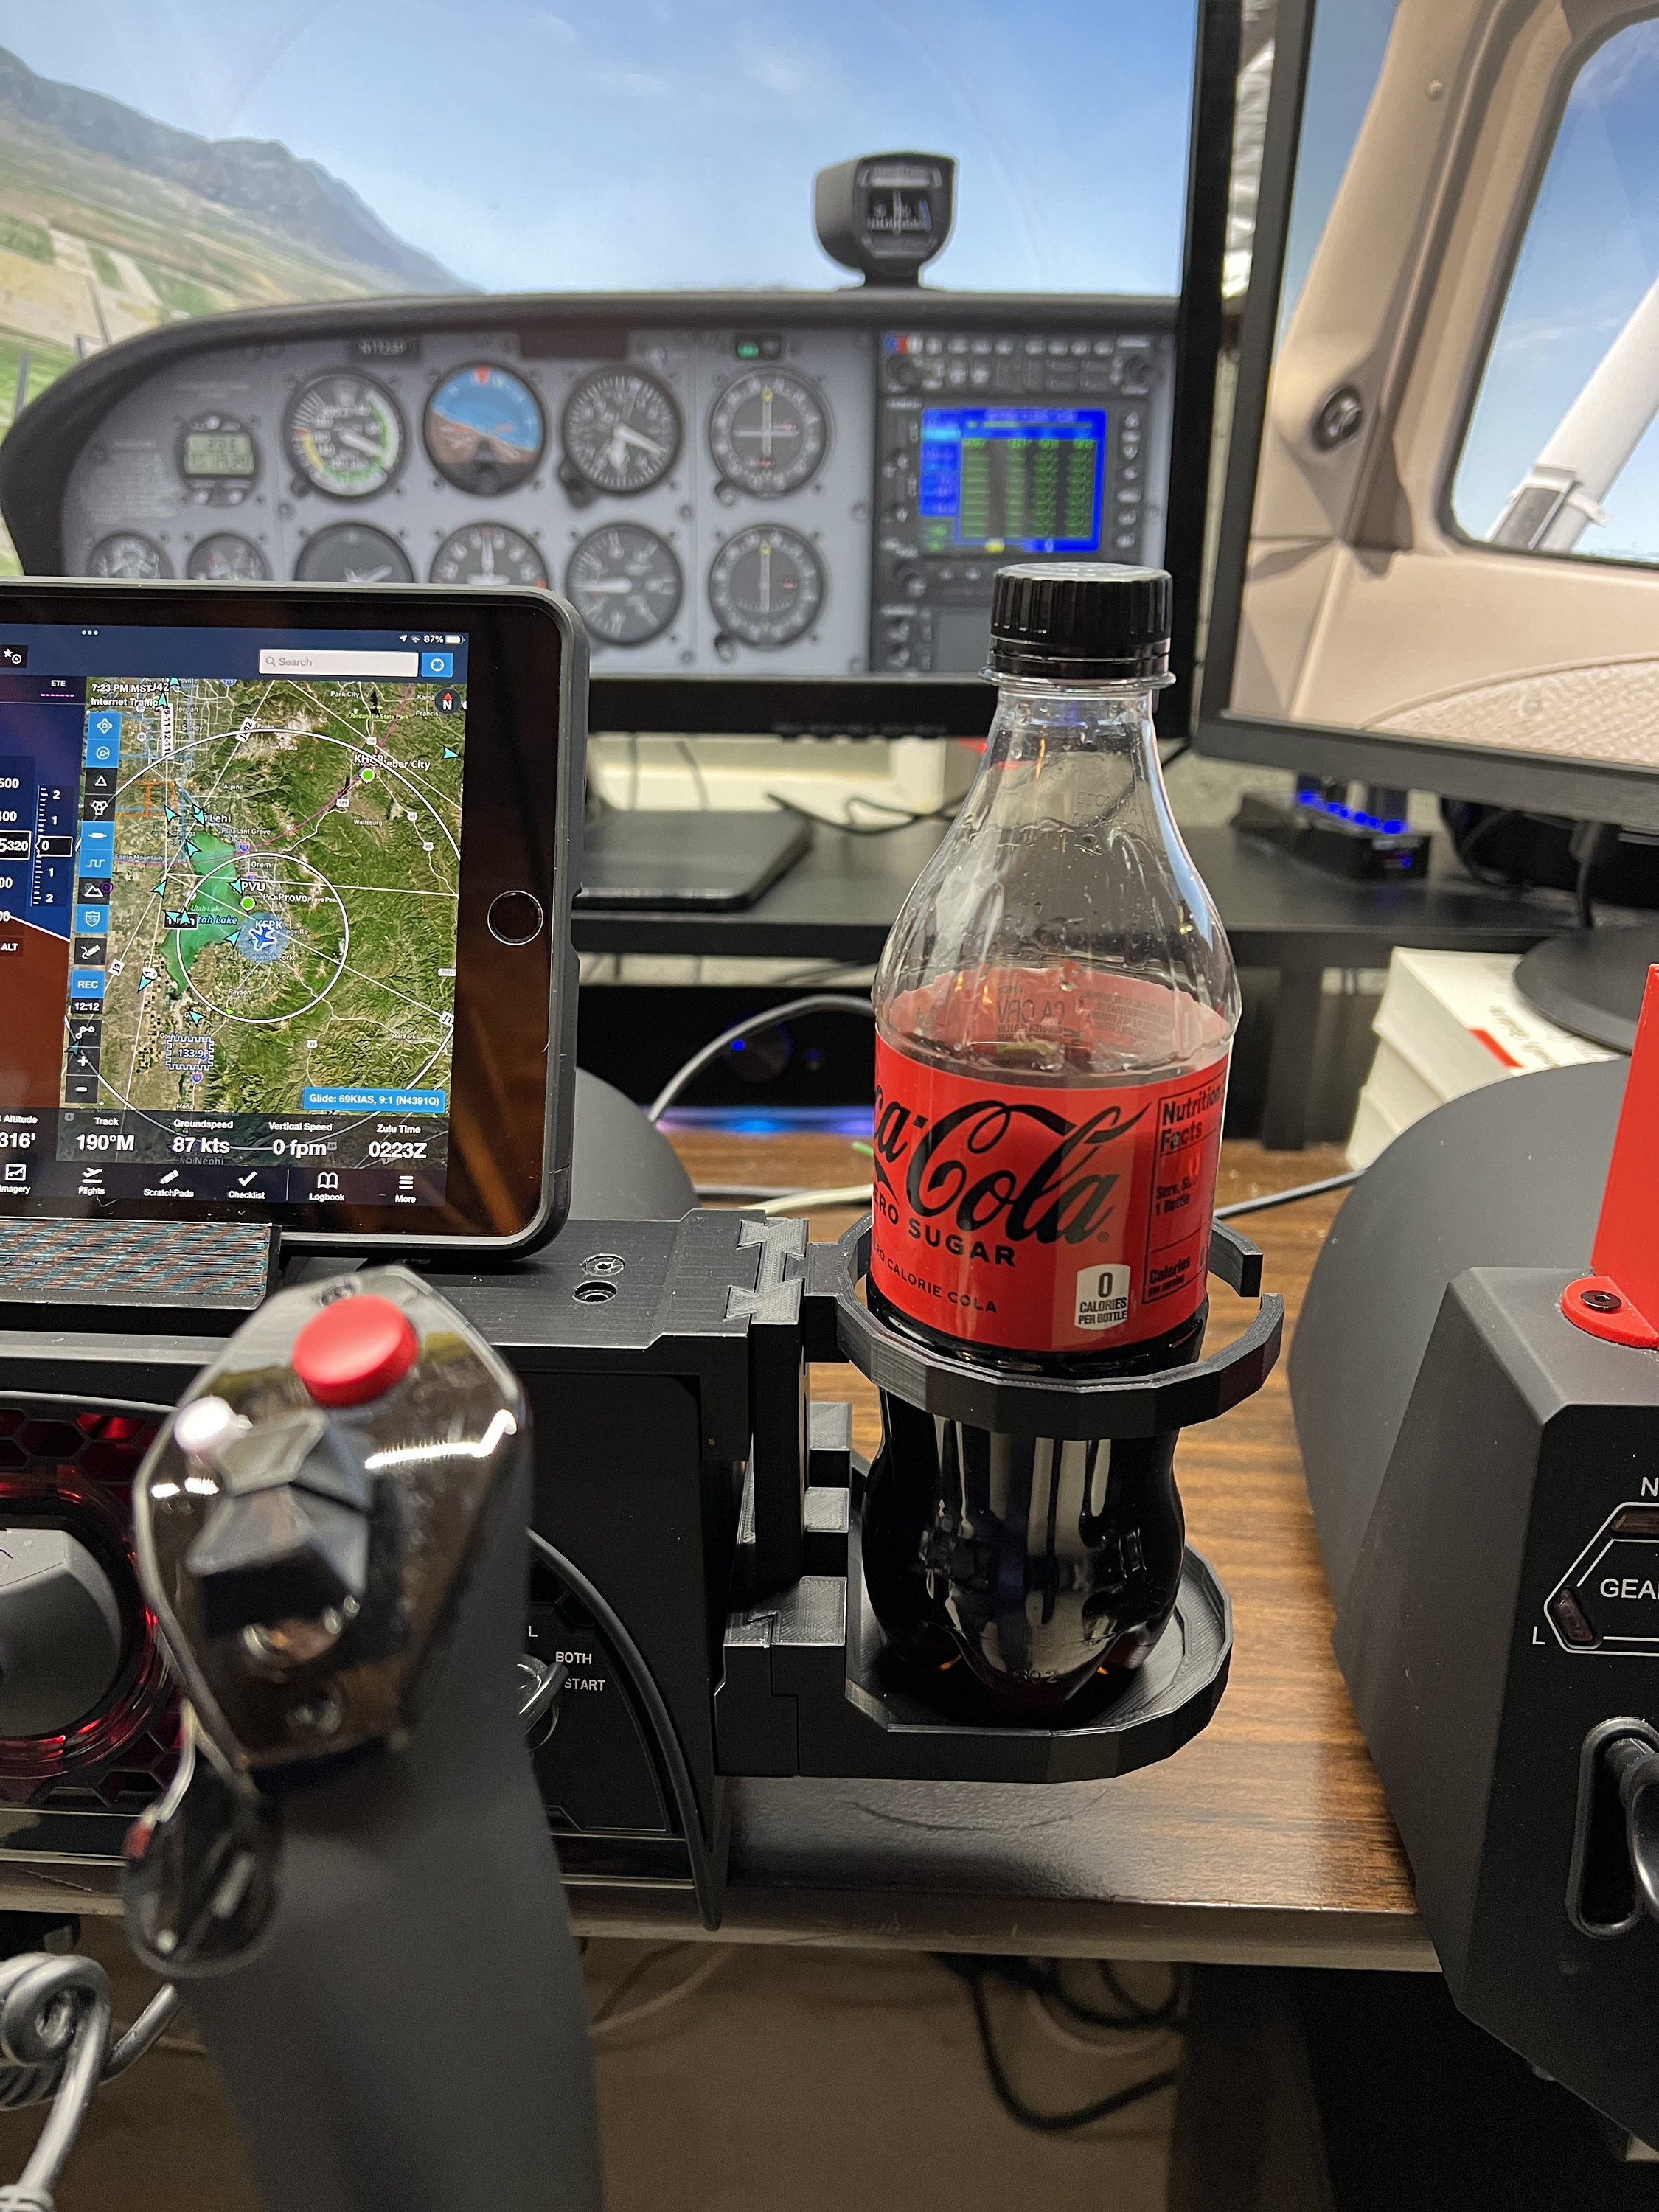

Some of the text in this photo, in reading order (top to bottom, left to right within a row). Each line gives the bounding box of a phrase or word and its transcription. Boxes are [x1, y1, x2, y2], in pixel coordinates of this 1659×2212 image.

[423, 635, 444, 644] 87%
[279, 658, 313, 667] Search
[91, 684, 152, 693] 7:23 PM MST
[347, 691, 361, 699] City
[91, 697, 159, 707] Internet Traffic
[443, 701, 453, 710] N
[181, 725, 204, 733] Sandy
[383, 758, 431, 771] eber City
[52, 790, 60, 800] 2
[0, 810, 18, 822] 00
[52, 815, 58, 826] 1
[210, 814, 232, 823] Lehi
[41, 840, 49, 851] 0
[48, 868, 54, 877] 1
[240, 881, 265, 891] PVU
[46, 893, 54, 903] 2
[279, 893, 308, 902] Provo
[198, 915, 215, 924] tah
[215, 916, 237, 925] Lake
[1, 943, 18, 951] ALT
[77, 980, 98, 989] REC
[74, 1002, 100, 1011] 12:12
[178, 1049, 204, 1058] 133.9
[309, 1093, 440, 1106] Glide: 69KIAS, 9:1 (N4391Q)
[4, 1115, 38, 1124] Altitude
[94, 1117, 119, 1126] Track
[173, 1119, 234, 1130] Groundspeed
[268, 1121, 333, 1133] Vertical Speed
[376, 1124, 421, 1134] Zulu Time
[1161, 1121, 1203, 1153] Facts
[76, 1134, 135, 1151] 190°M
[173, 1136, 231, 1154] 87 kts
[273, 1139, 327, 1159] 0 fpm
[369, 1141, 428, 1159] 0223Z
[78, 1186, 105, 1196] Flights
[143, 1189, 195, 1197] ScratchPads
[228, 1190, 265, 1200] Checklist
[309, 1193, 345, 1202] Logbook
[394, 1194, 417, 1203] More
[908, 1218, 1016, 1267] SUGAR
[1150, 1256, 1191, 1284] Calories
[887, 1258, 942, 1298] CALORIE
[947, 1291, 997, 1313] COLA
[1098, 1272, 1113, 1298] 0
[1079, 1297, 1127, 1313] CALORIES
[1079, 1310, 1127, 1324] PER BOTTLE
[1641, 1476, 1659, 1497] N
[1600, 1579, 1659, 1599] GEA
[529, 1626, 538, 1638] L
[1532, 1626, 1545, 1645] L
[555, 1651, 592, 1665] BOTH
[564, 1678, 606, 1691] START
